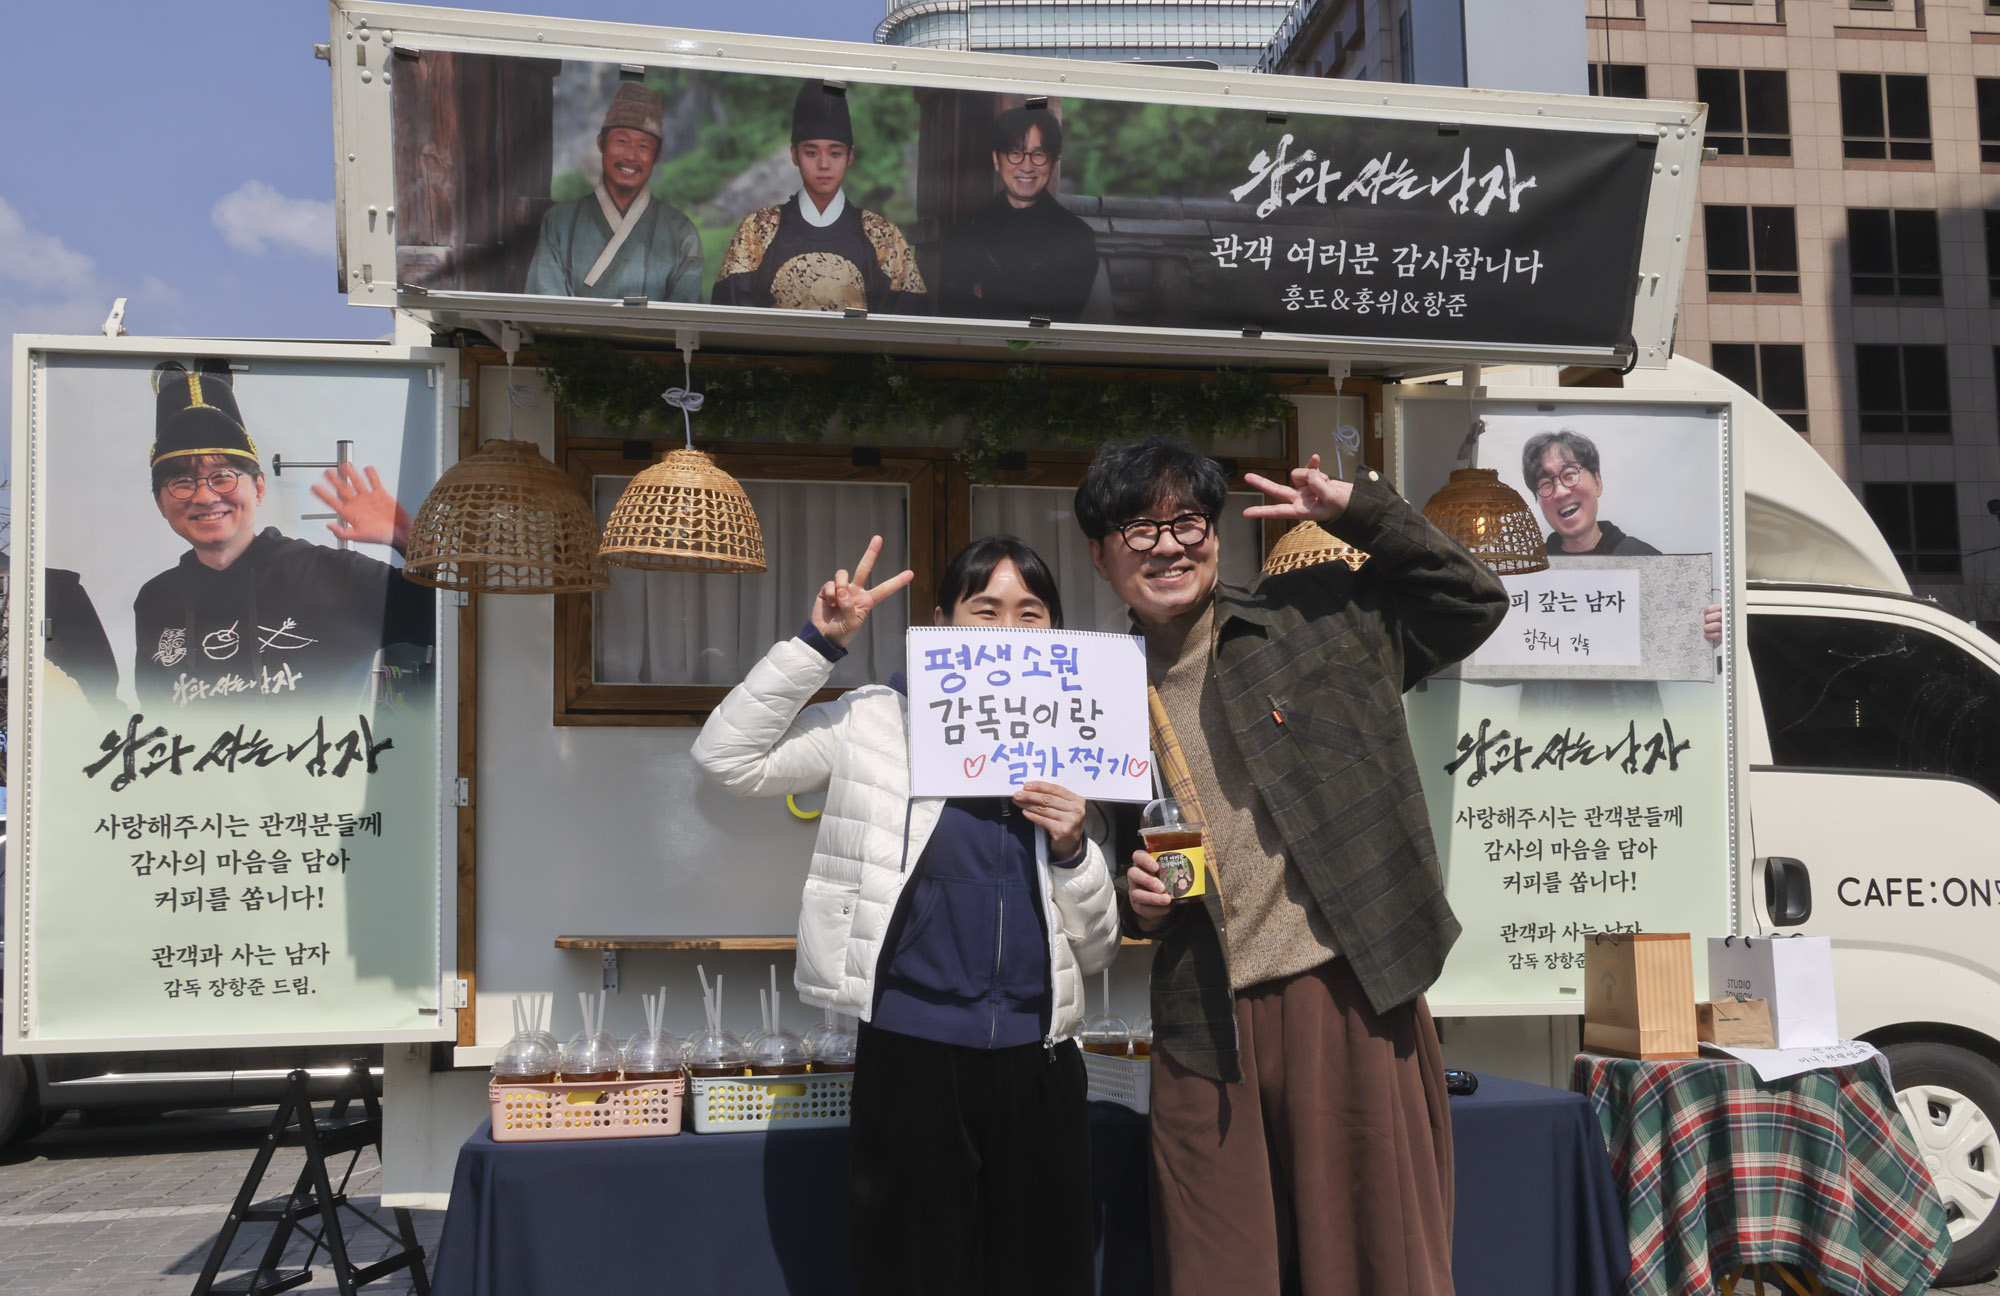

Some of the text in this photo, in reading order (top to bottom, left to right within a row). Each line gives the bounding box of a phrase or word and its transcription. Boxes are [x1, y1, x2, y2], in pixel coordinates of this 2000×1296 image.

[1230, 133, 1538, 219] 왕과 사는 남자
[1210, 233, 1544, 285] 관객 여러분 감사합니다
[1510, 589, 1530, 614] 피
[1585, 590, 1626, 614] 남자
[929, 694, 1104, 746] 감독님이랑
[82, 713, 395, 792] 왕과 사는 남자
[1444, 718, 1692, 788] 왕과 사는 남자
[94, 811, 382, 841] 사랑해주시는 관객분들께
[1455, 805, 1683, 830] 사랑해주시는 관객분들께
[1484, 836, 1658, 862] 감사의 마음을 담아
[130, 848, 351, 877] 감사의 마음을 담아
[1502, 870, 1638, 895] 커피를 쏩니다!
[154, 884, 324, 913] 커피를 쏩니다!
[1500, 922, 1556, 944] 관객과
[151, 942, 331, 968] 관객과 사는 남자
[1508, 952, 1539, 970] 감독
[163, 976, 316, 998] 감독 장항준 드림.
[1727, 978, 1752, 990] STUDIO
